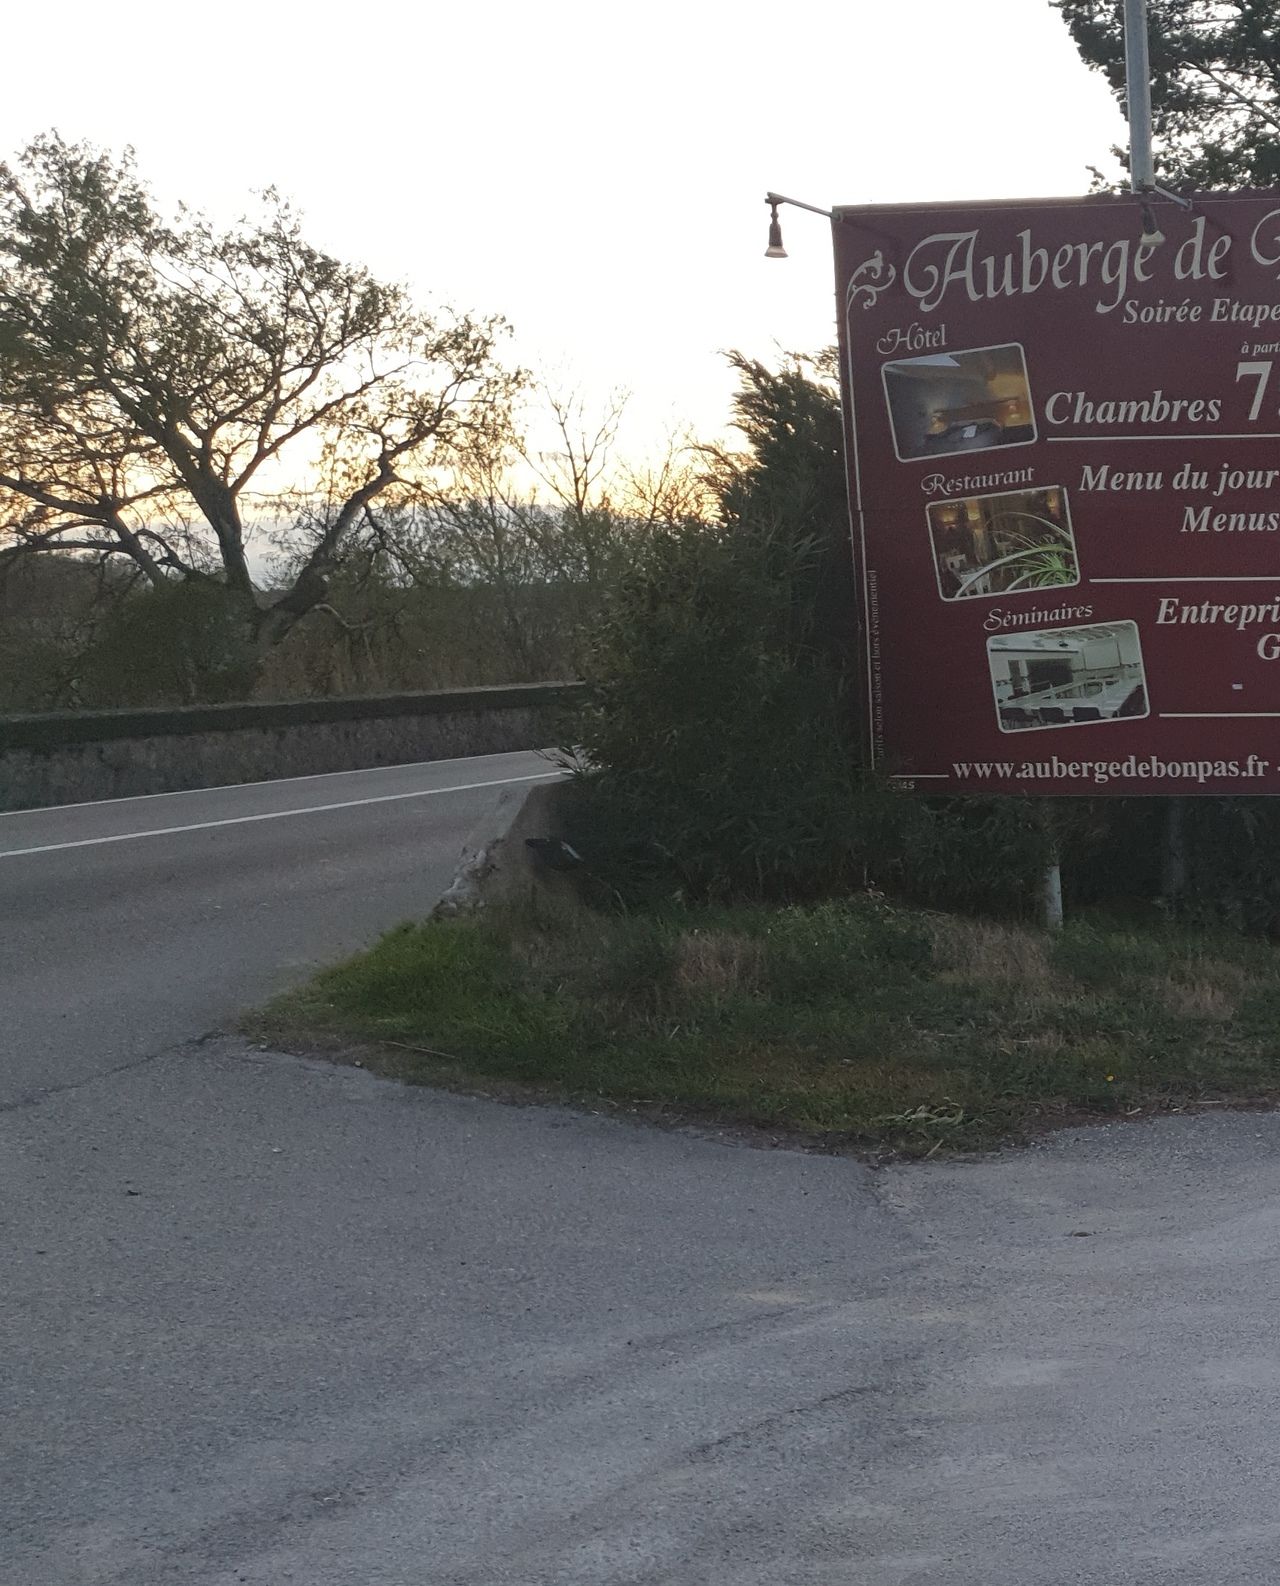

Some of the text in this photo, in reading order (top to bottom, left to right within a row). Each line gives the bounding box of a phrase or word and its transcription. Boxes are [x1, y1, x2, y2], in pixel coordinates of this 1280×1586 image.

[903, 228, 1156, 313] Auberge
[1174, 216, 1232, 280] de
[1123, 299, 1202, 324] Soirée
[876, 322, 948, 354] Hôtel
[1241, 341, 1249, 354] à
[1045, 391, 1222, 424] Chambres
[920, 466, 1035, 496] Restaurant
[1079, 463, 1280, 497] Menu du jour
[1180, 506, 1280, 532] Menus
[983, 603, 1093, 631] Séminaires
[953, 755, 1268, 783] www.aubergedebonpas.fr
